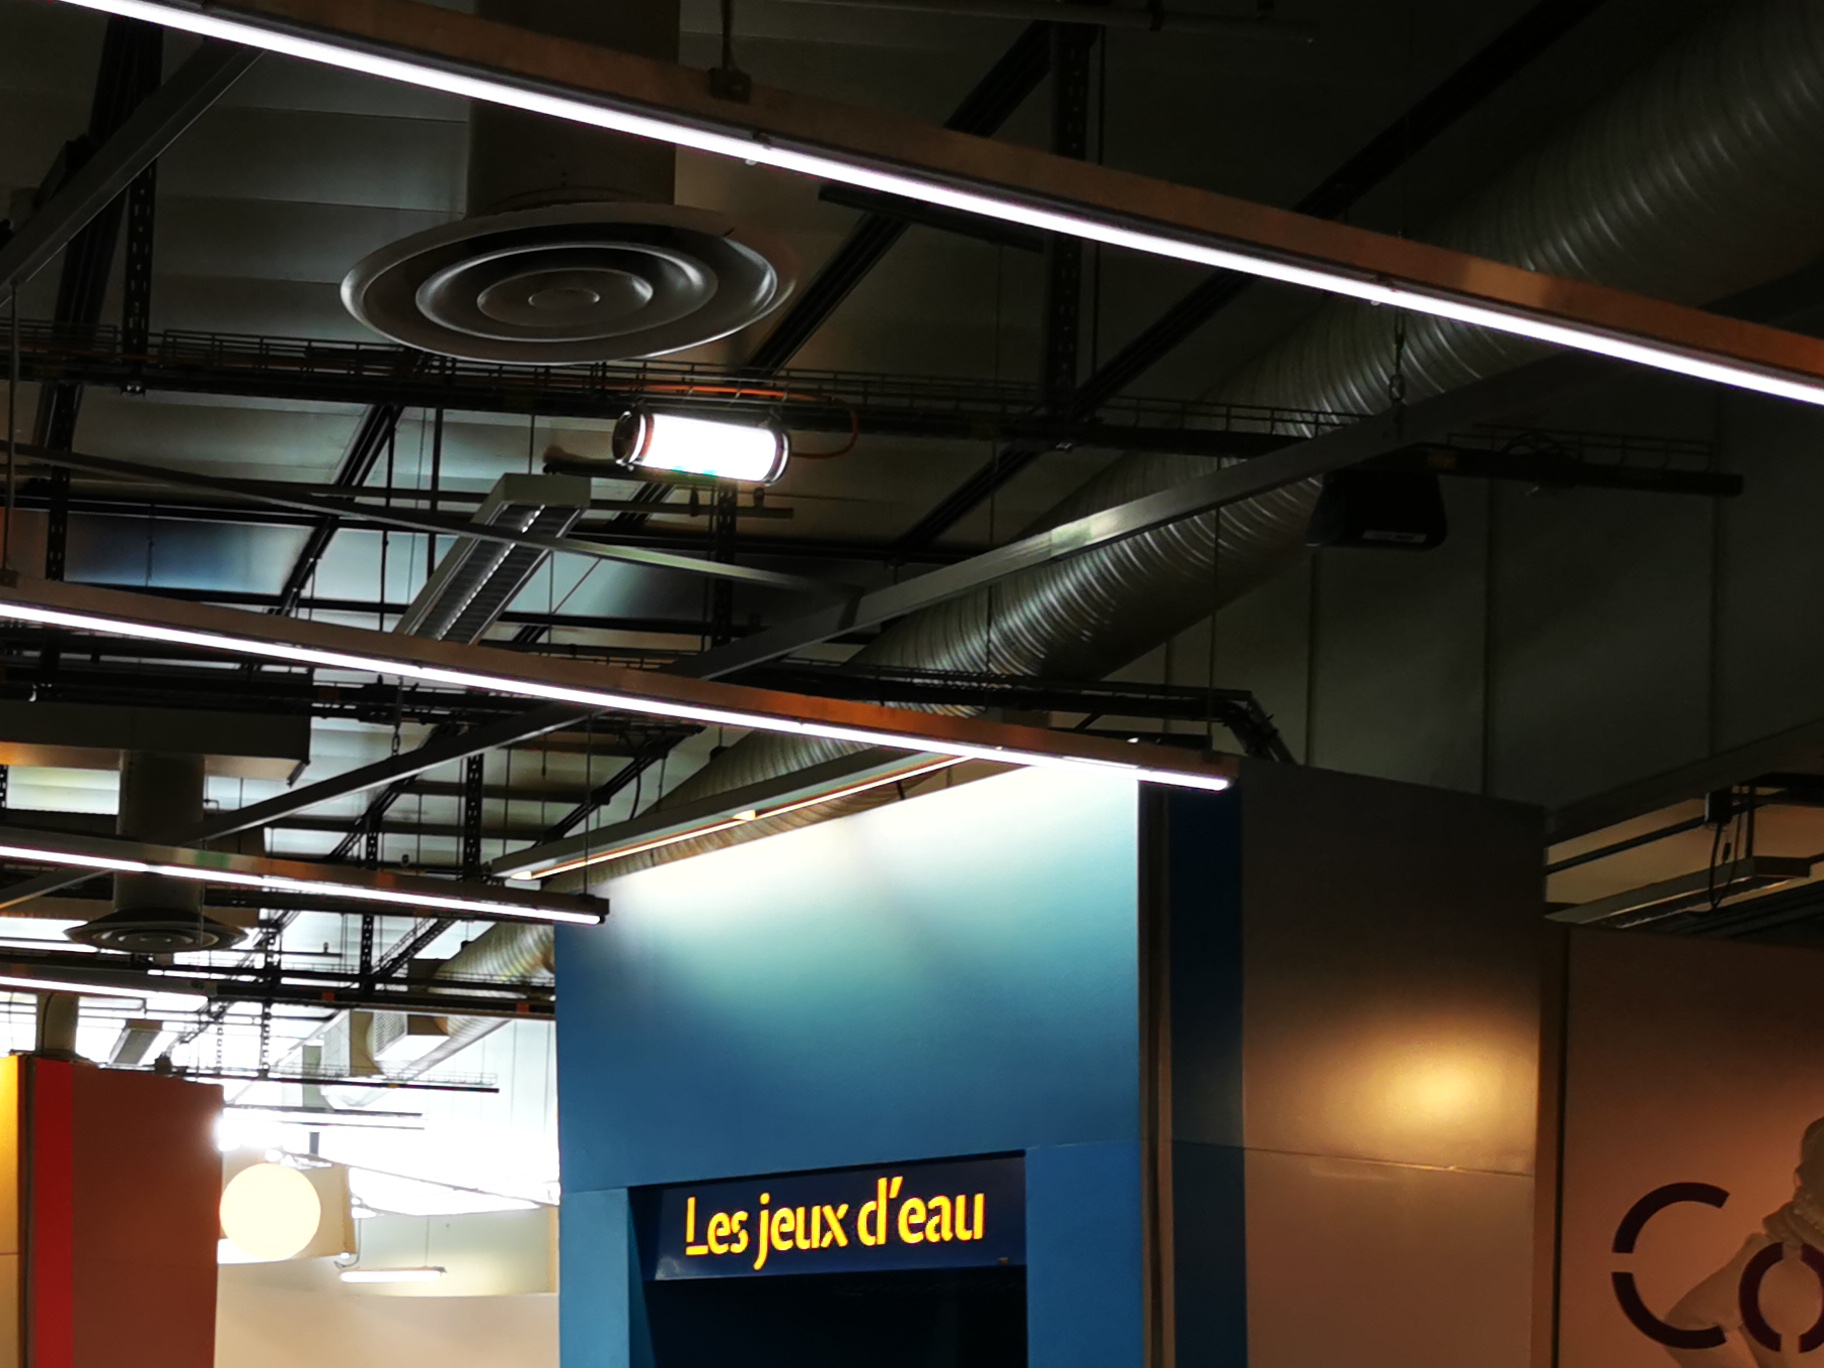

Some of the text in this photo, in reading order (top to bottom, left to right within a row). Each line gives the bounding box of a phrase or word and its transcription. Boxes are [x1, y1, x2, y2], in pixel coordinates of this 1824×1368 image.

[685, 1175, 986, 1271] Les jeux d'eau
